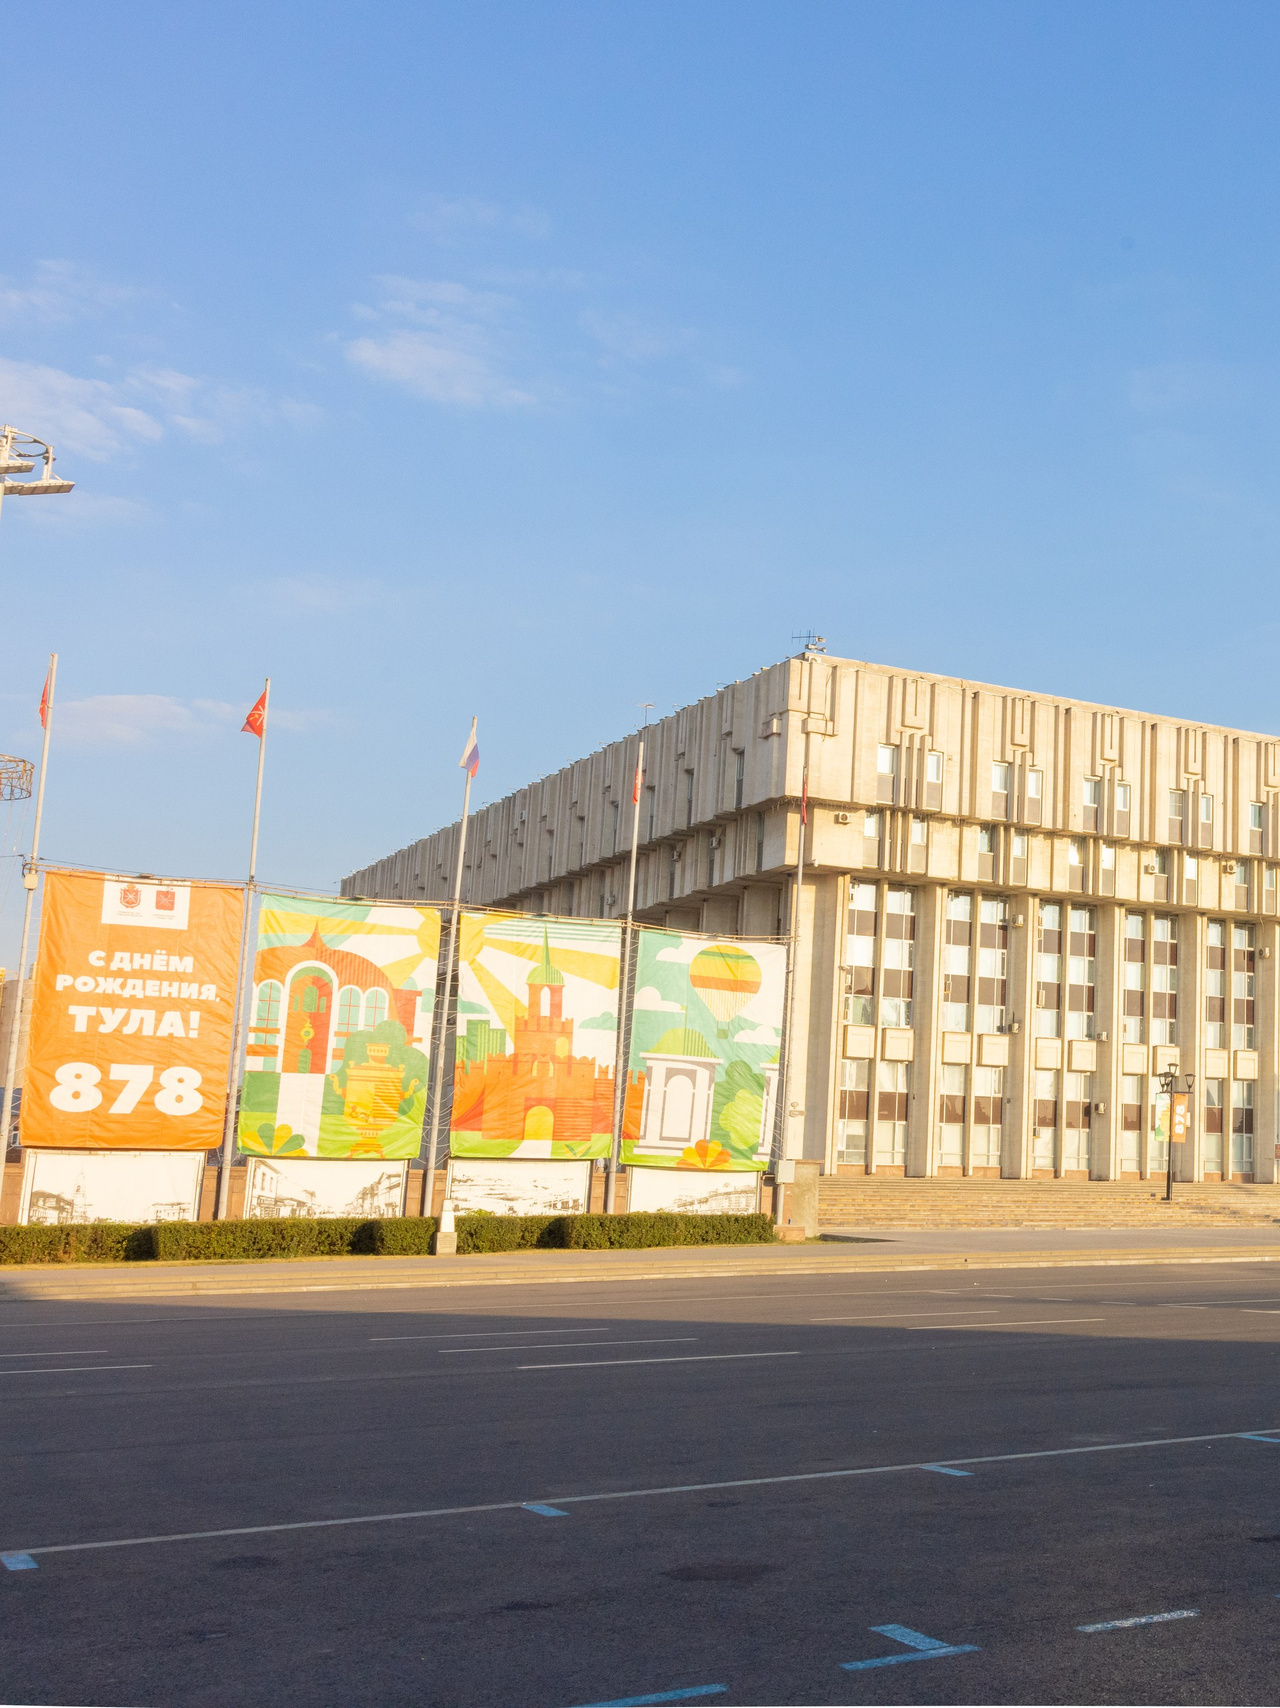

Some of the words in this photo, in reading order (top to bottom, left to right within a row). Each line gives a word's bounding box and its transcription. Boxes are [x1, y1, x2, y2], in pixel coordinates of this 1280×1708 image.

[88, 950, 106, 967] С
[110, 949, 194, 973] ДНЁМ
[55, 974, 221, 1002] РОЖДЕНИЯ,
[68, 1005, 201, 1038] ТУЛА!
[49, 1061, 204, 1116] 878
[1174, 1104, 1185, 1135] 878
